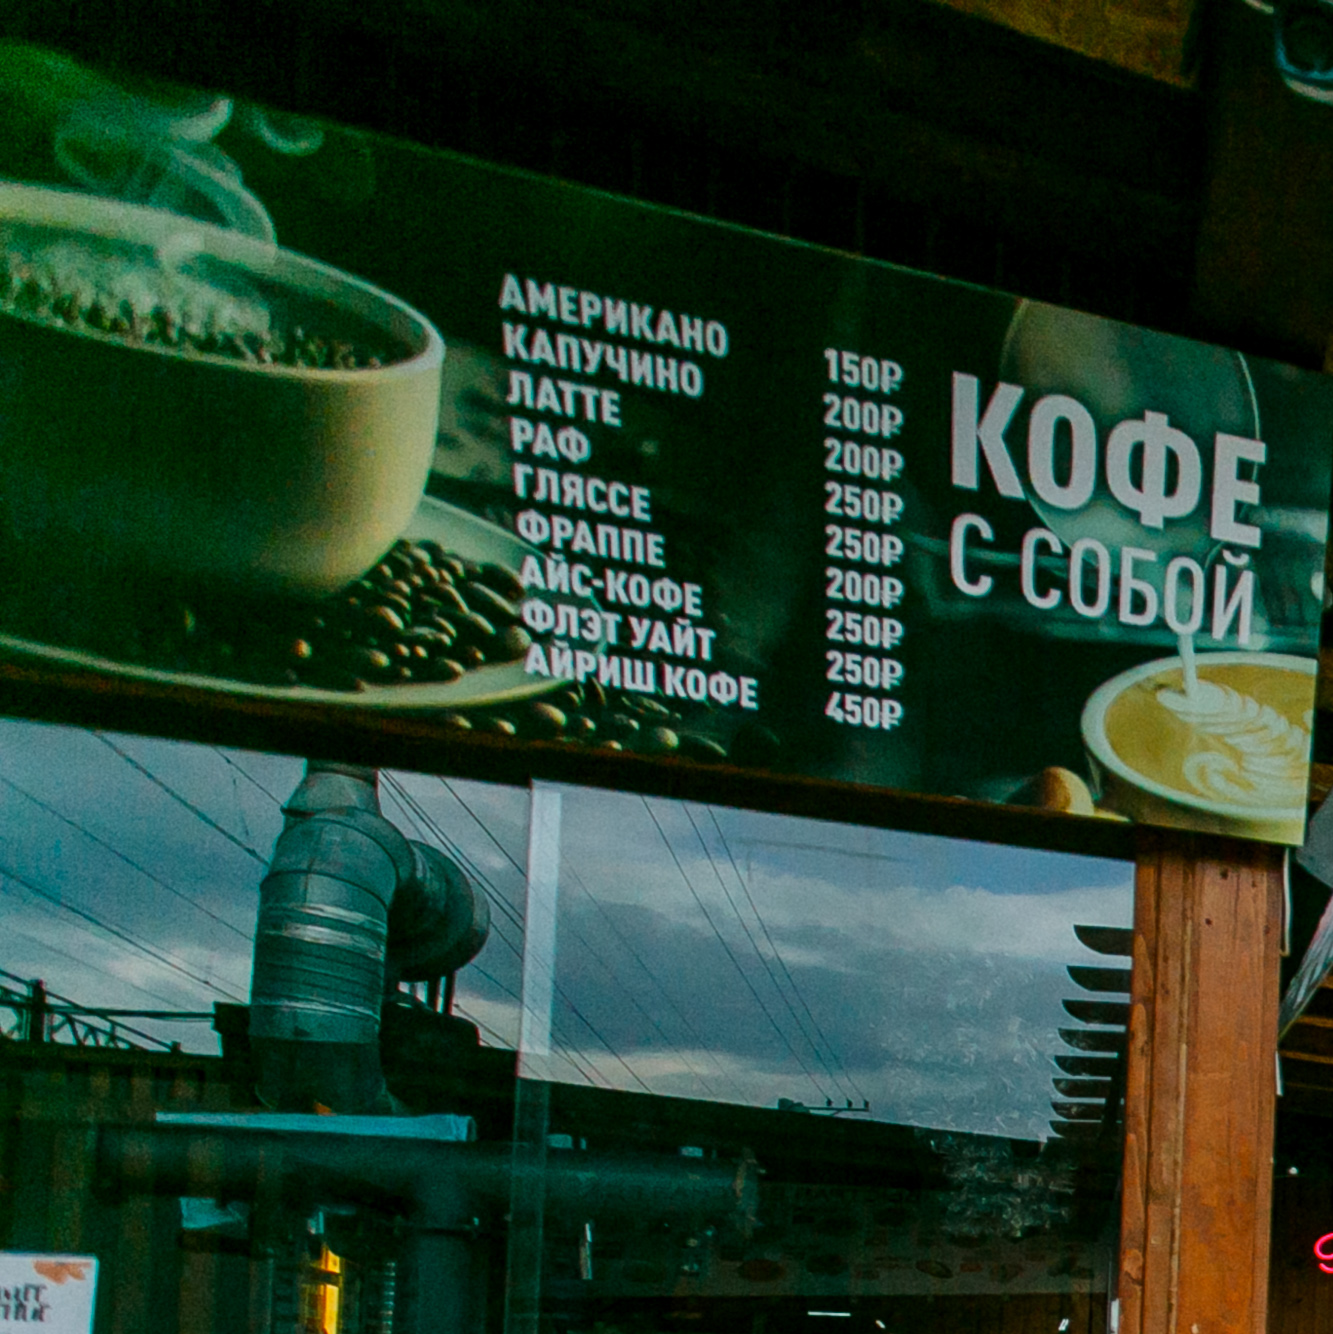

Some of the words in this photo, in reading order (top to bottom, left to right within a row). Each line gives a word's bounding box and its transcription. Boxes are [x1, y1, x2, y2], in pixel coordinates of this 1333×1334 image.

[500, 273, 729, 358] АМЕРИКАНО
[502, 322, 704, 398] КАПУЧИНО
[506, 371, 622, 428] ЛАТТЕ
[509, 416, 591, 464] РАФ
[951, 370, 1266, 549] КОФЕ
[512, 463, 652, 522] ГЛЯССЕ
[516, 508, 666, 568] ФРАППЕ
[519, 552, 703, 617] АЙС-КОФЕ
[949, 512, 995, 597] С
[1020, 526, 1255, 646] СОБОЙ
[522, 597, 623, 645] ФЛЭТ
[631, 614, 716, 661] УАЙТ
[524, 641, 656, 693] АЙРИШ
[663, 663, 759, 711] КОФЕ
